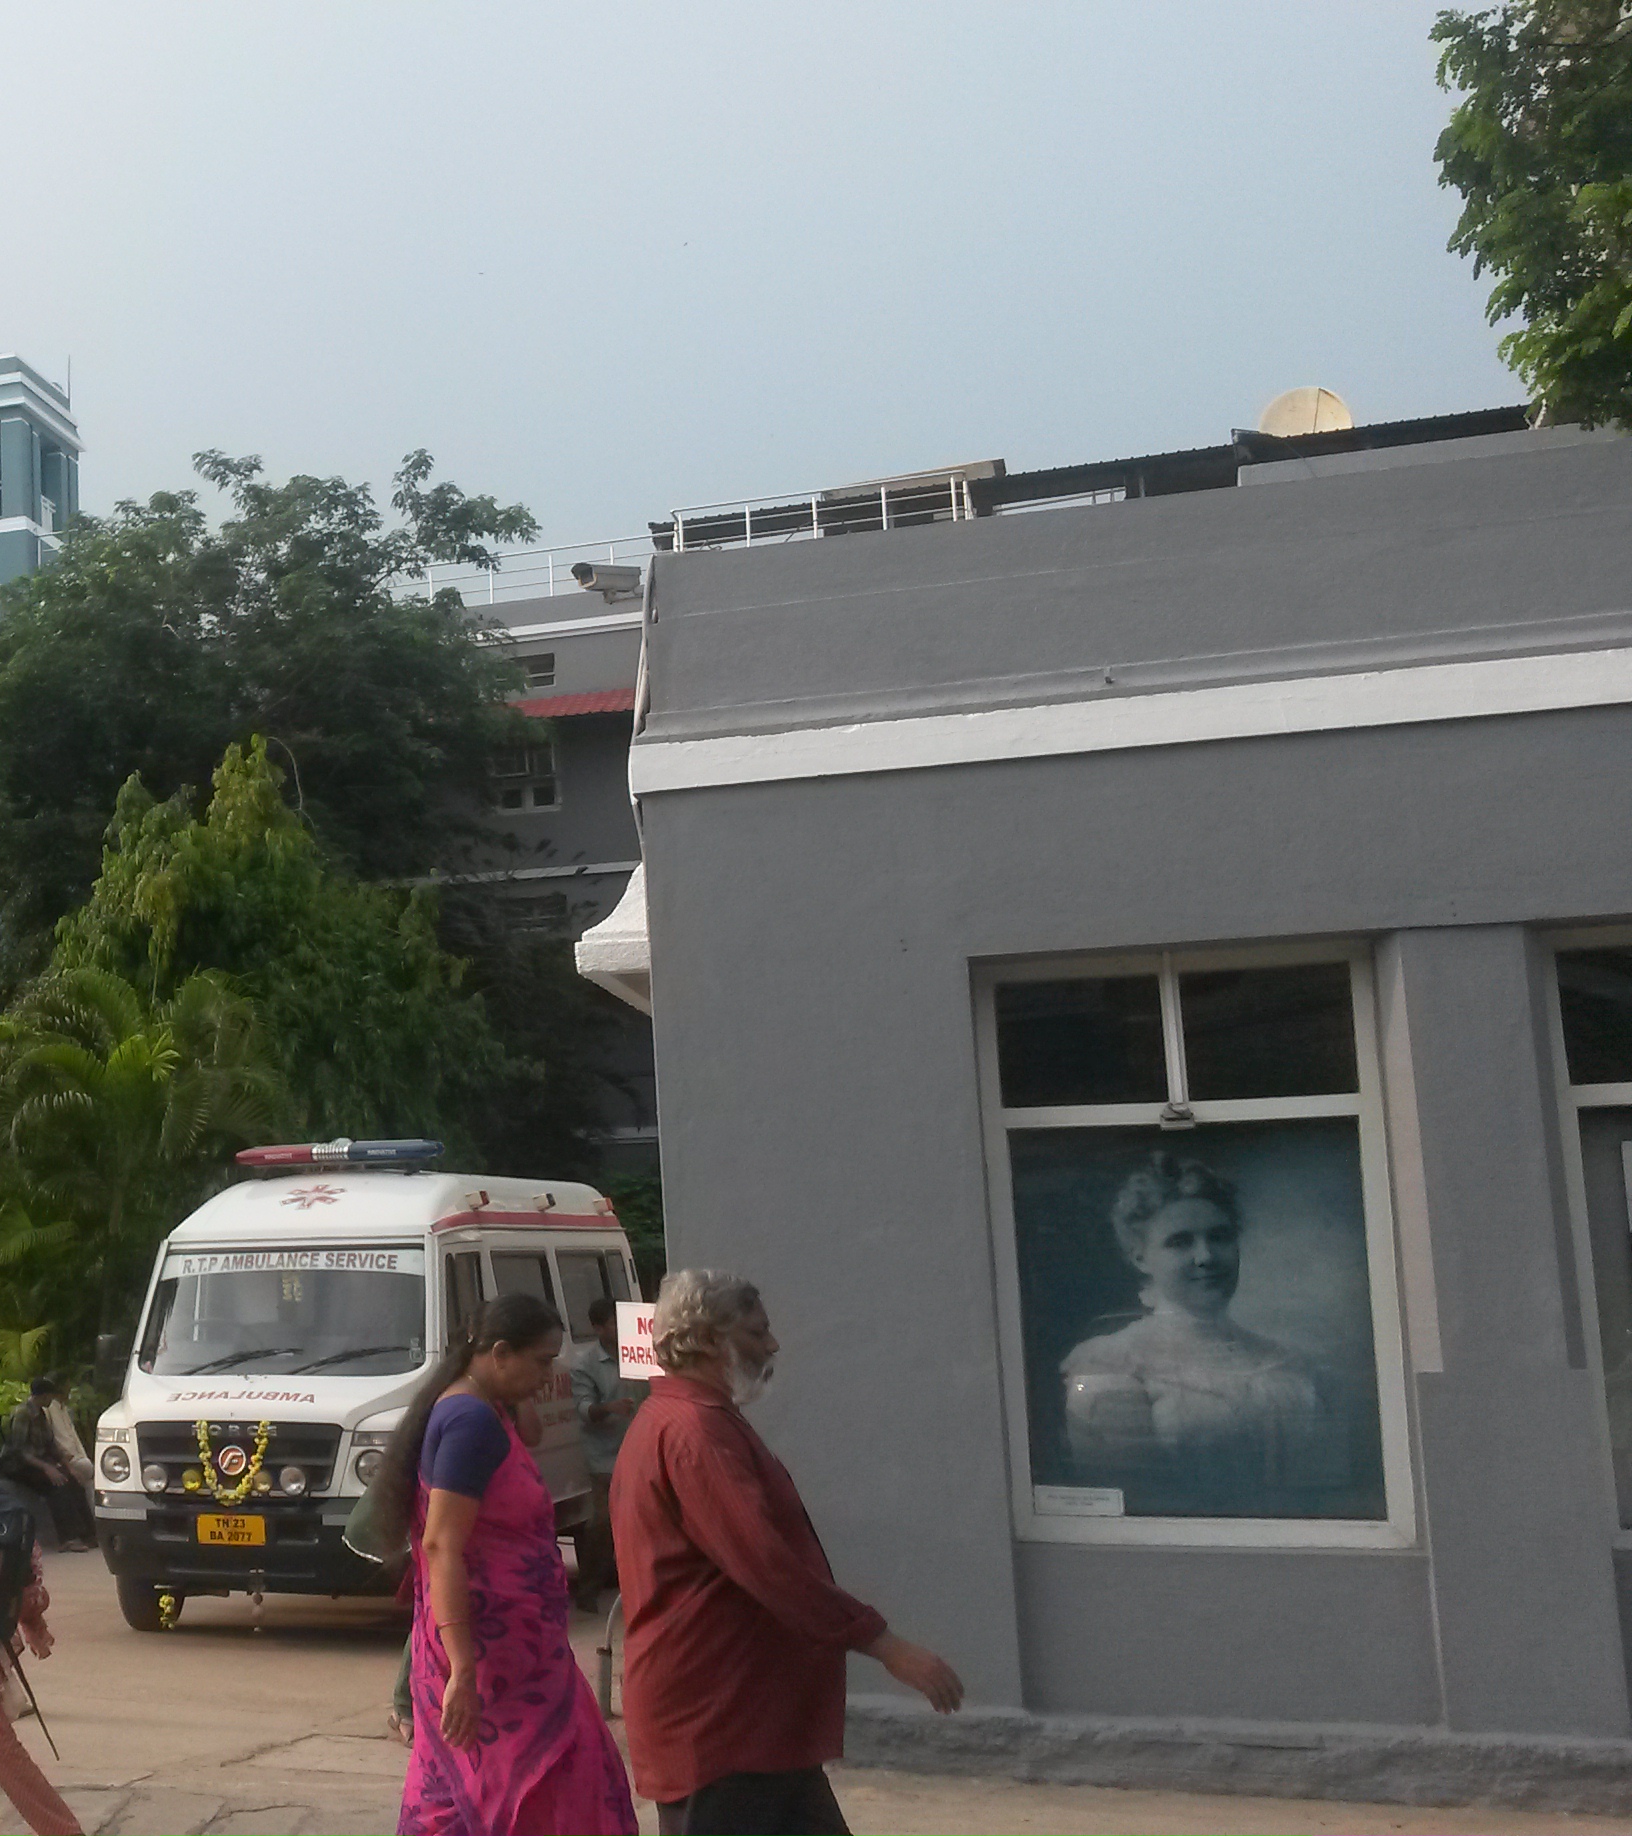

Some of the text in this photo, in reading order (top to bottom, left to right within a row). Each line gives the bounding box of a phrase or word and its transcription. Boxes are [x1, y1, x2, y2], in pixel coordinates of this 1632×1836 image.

[182, 1252, 398, 1275] R.T.P AMBULANCE SERVICE
[621, 1346, 658, 1365] PARKI
[233, 1518, 245, 1528] 23
[210, 1531, 252, 1541] BA 2077
